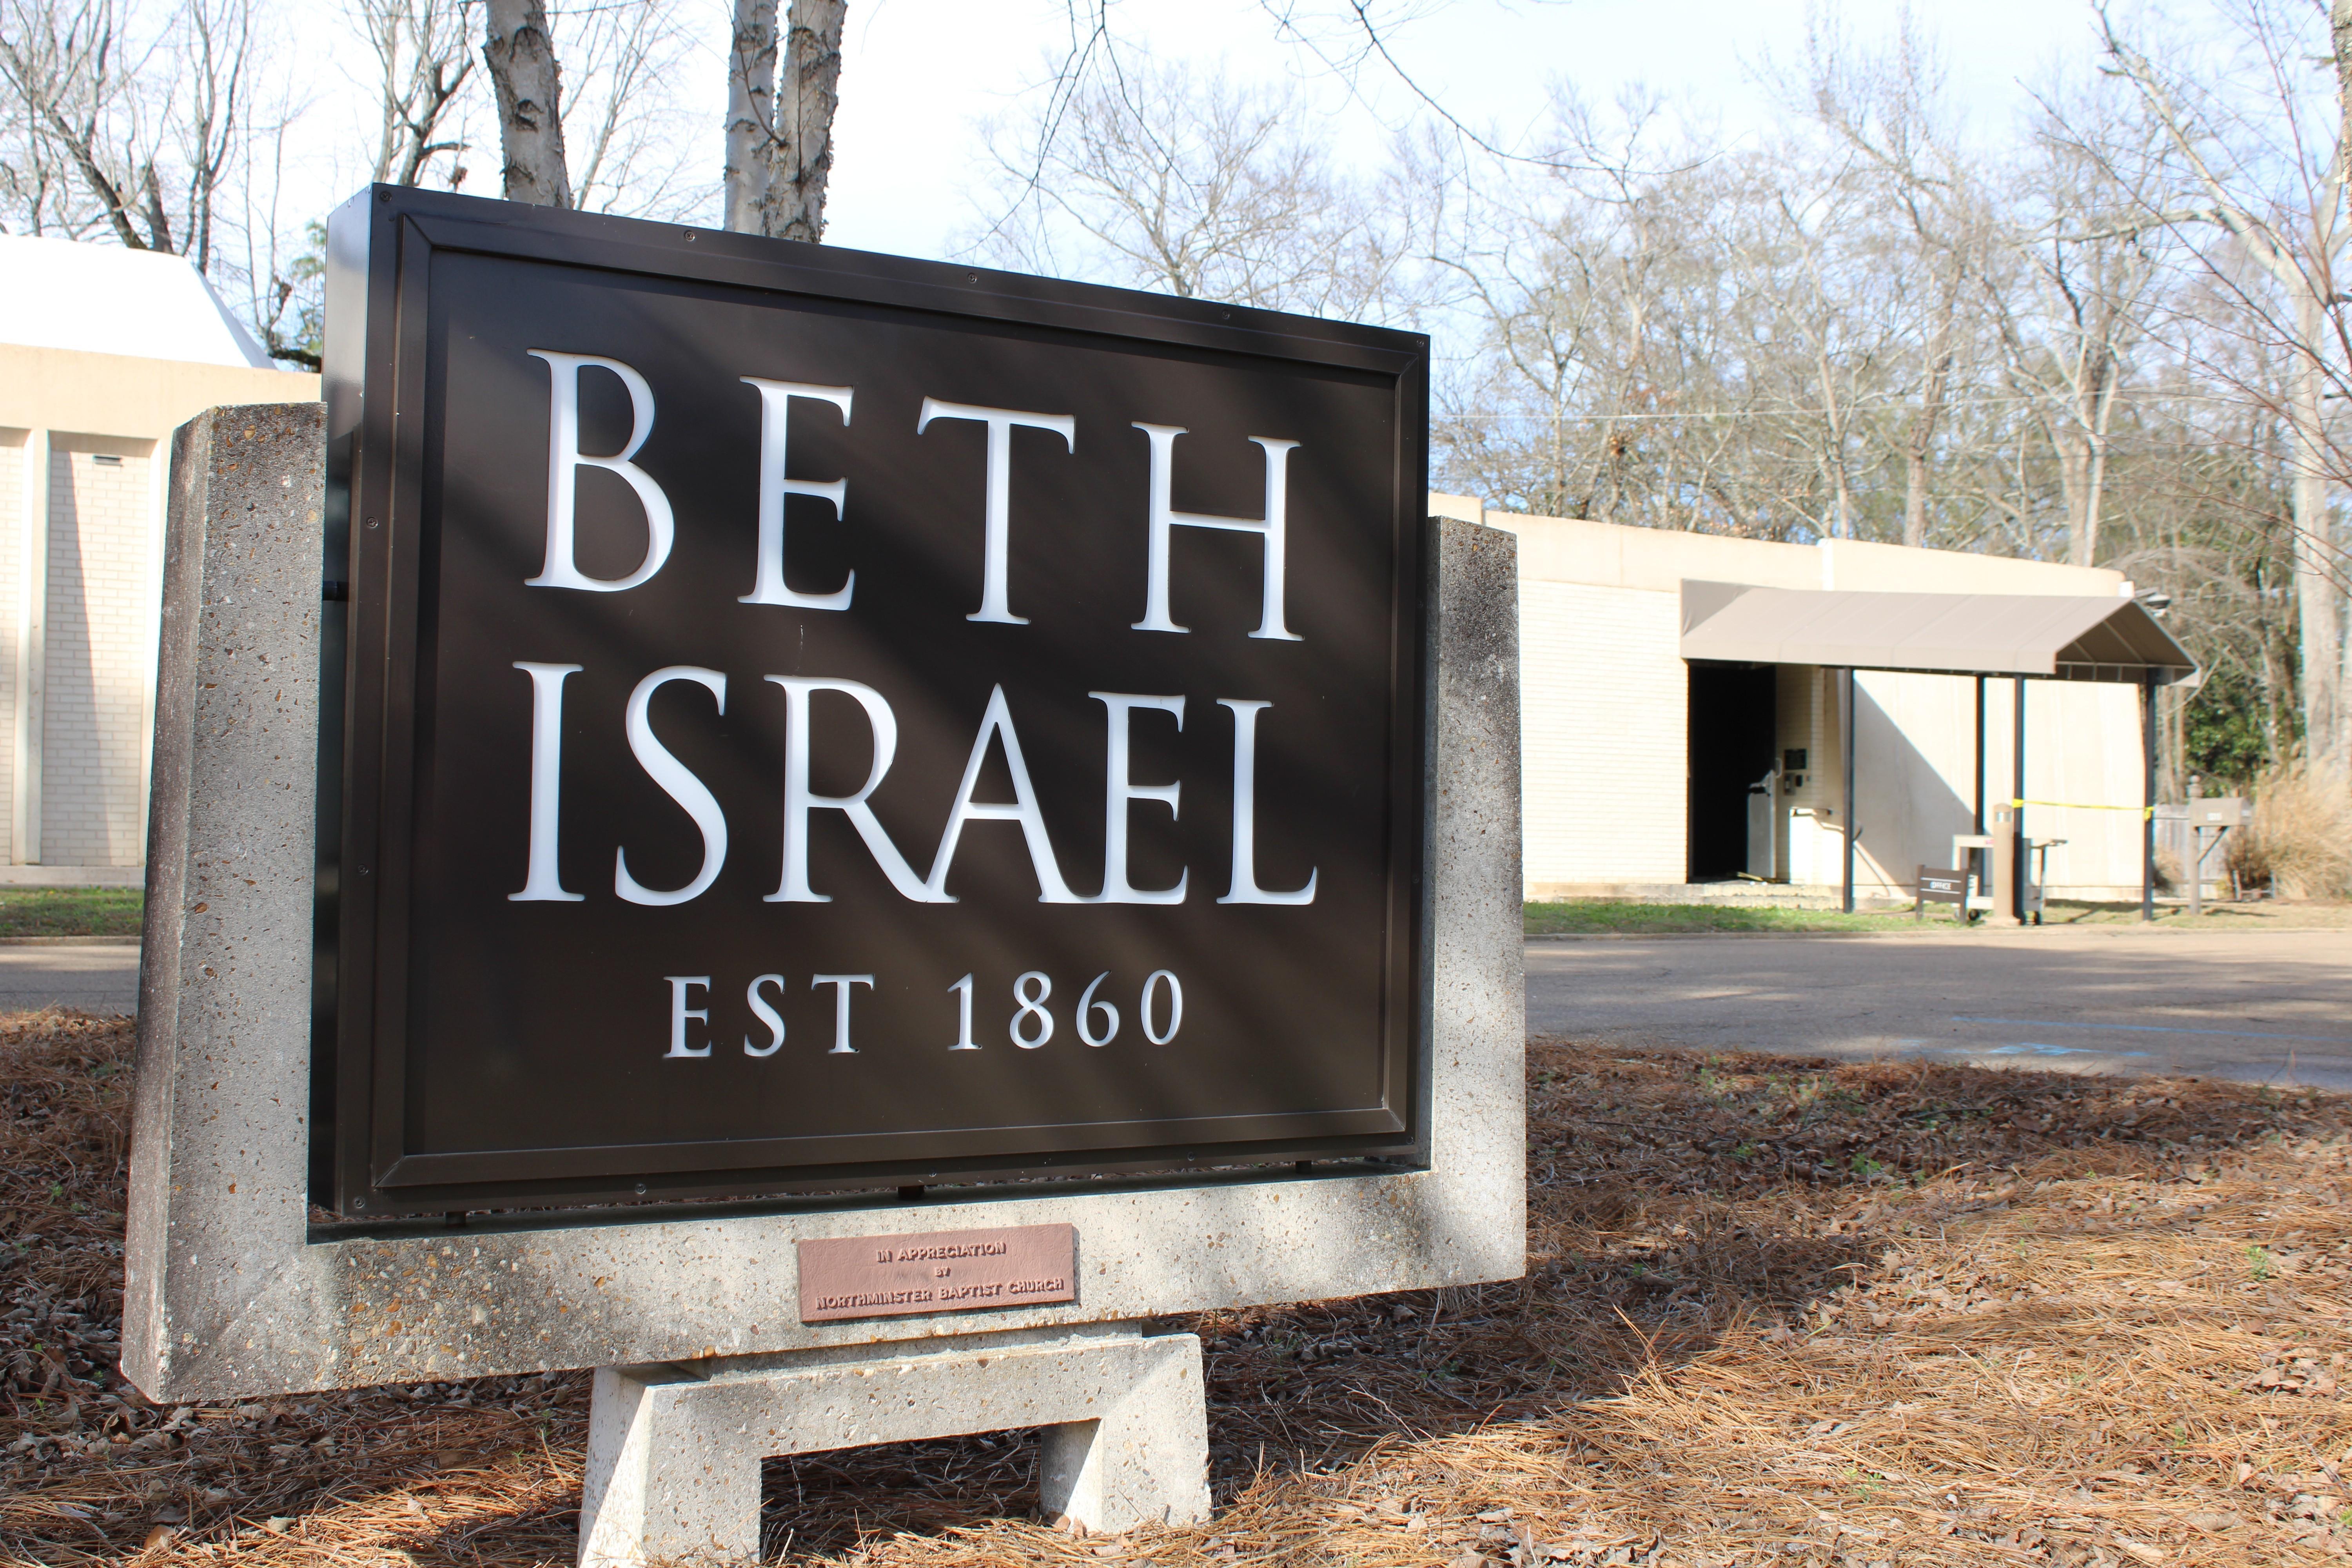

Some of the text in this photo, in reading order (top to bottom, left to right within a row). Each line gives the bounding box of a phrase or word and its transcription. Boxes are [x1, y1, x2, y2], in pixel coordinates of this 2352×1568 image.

[524, 350, 1303, 642] BETH
[508, 662, 1319, 907] ISRAEL
[1930, 881, 1952, 890] OFFICE
[663, 969, 1183, 1059] EST 1860
[877, 1241, 1007, 1263] IN APPRECIATION
[935, 1266, 951, 1277] BY
[816, 1278, 1064, 1310] NORTHMINSTER BAPTIST CHURCH
